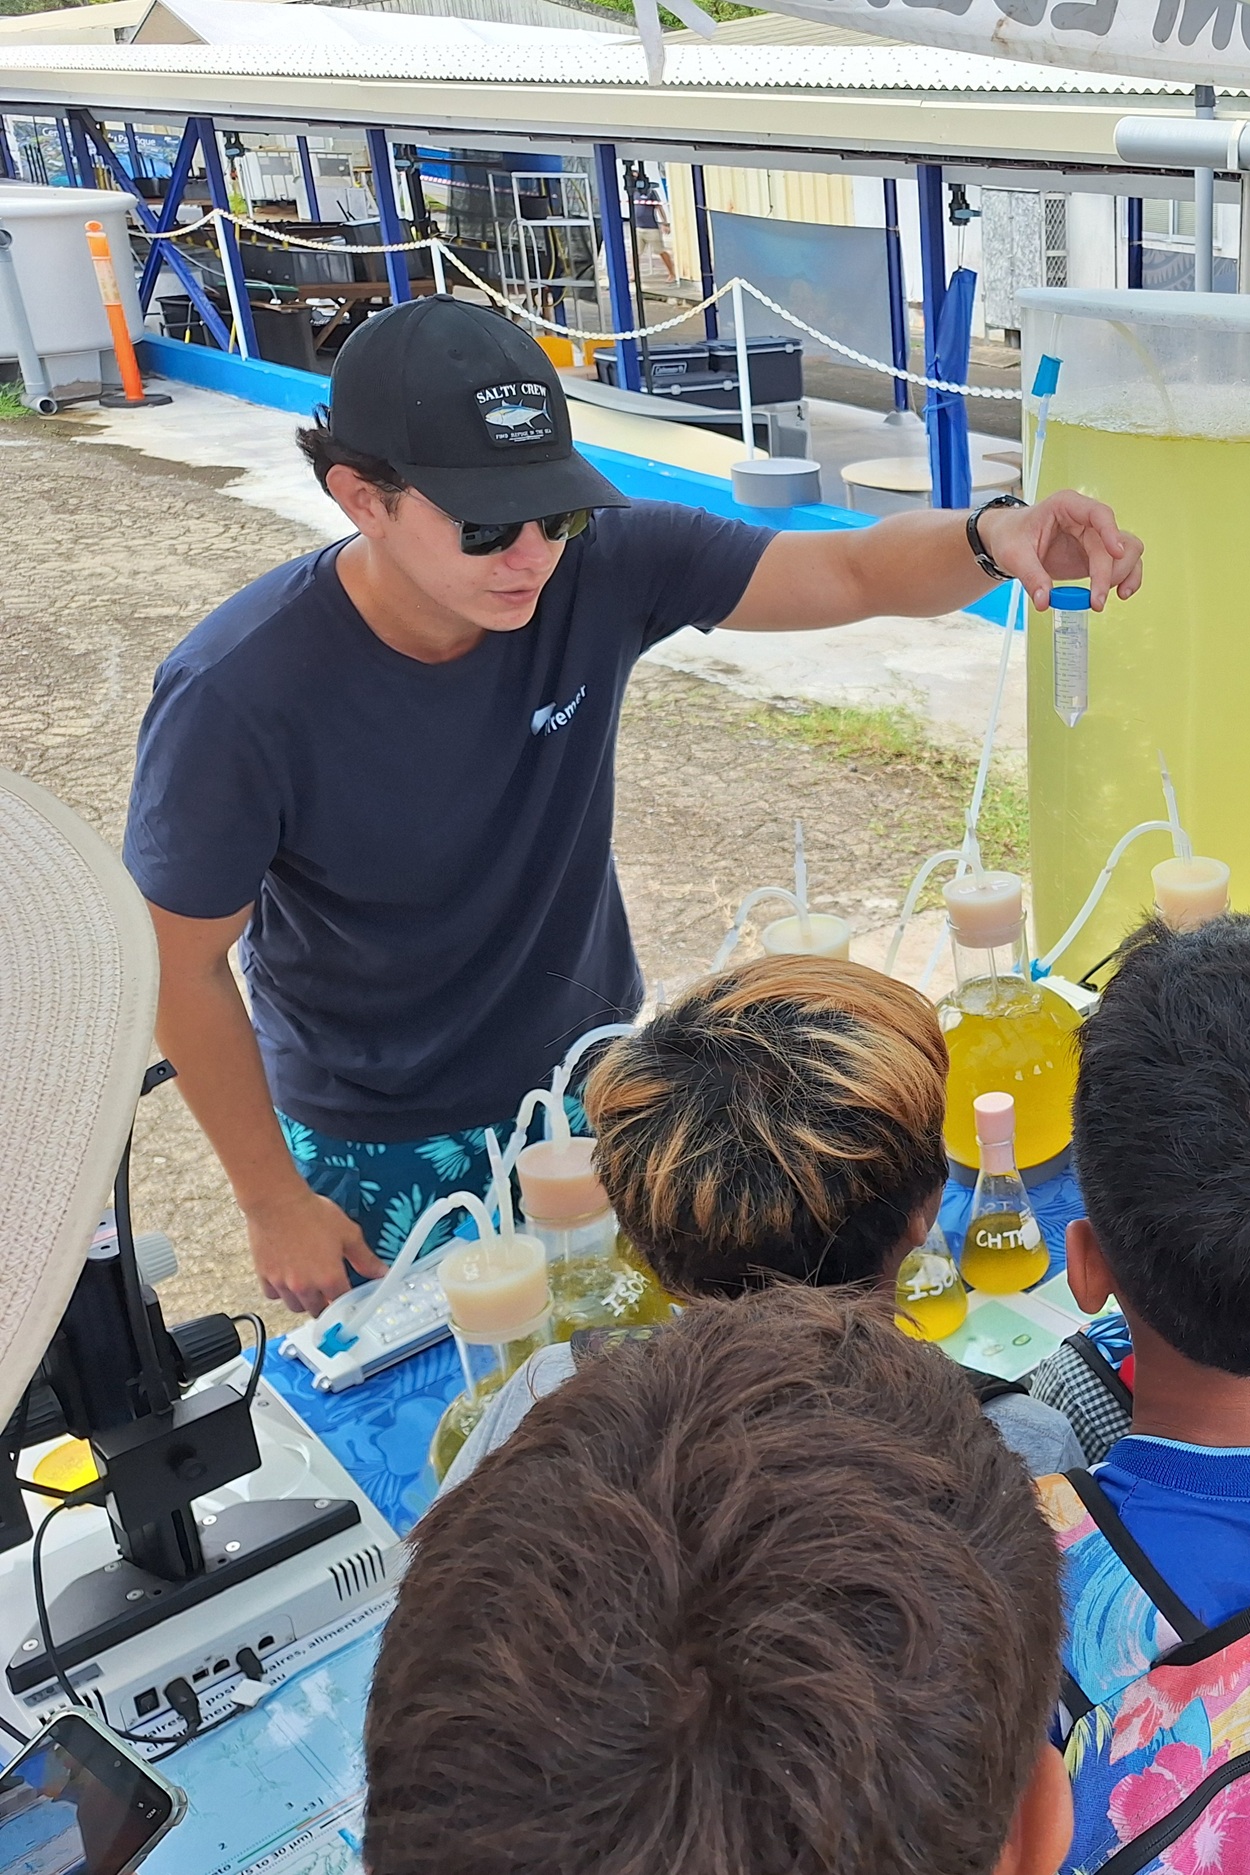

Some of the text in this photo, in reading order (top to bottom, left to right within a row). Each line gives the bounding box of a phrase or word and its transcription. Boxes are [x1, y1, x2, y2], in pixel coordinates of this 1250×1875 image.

[476, 383, 547, 404] SALTY CREW
[256, 1858, 270, 1870] to
[272, 1846, 287, 1860] 30
